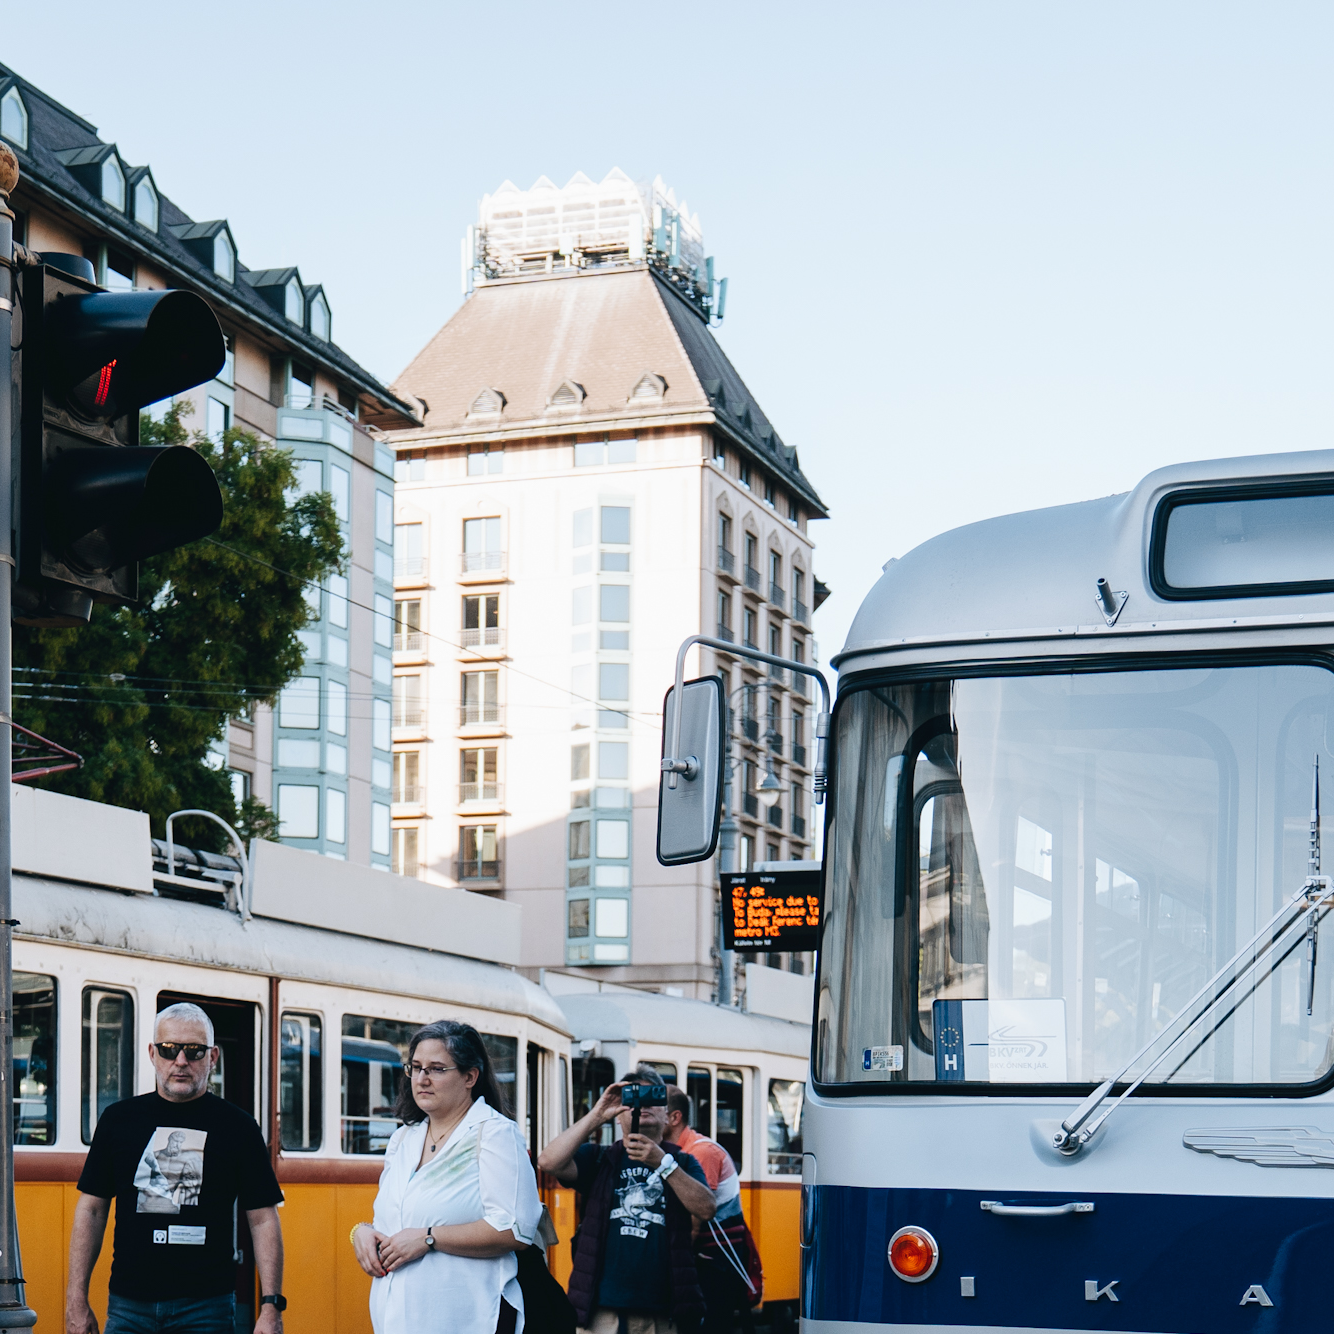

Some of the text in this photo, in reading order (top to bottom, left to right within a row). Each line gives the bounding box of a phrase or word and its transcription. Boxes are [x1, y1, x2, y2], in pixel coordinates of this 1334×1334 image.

[747, 896, 784, 907] service
[786, 895, 804, 906] due
[734, 928, 763, 937] metro
[989, 1048, 1014, 1058] BKV
[944, 1054, 957, 1071] H
[1006, 1061, 1034, 1070] ÖNNEK
